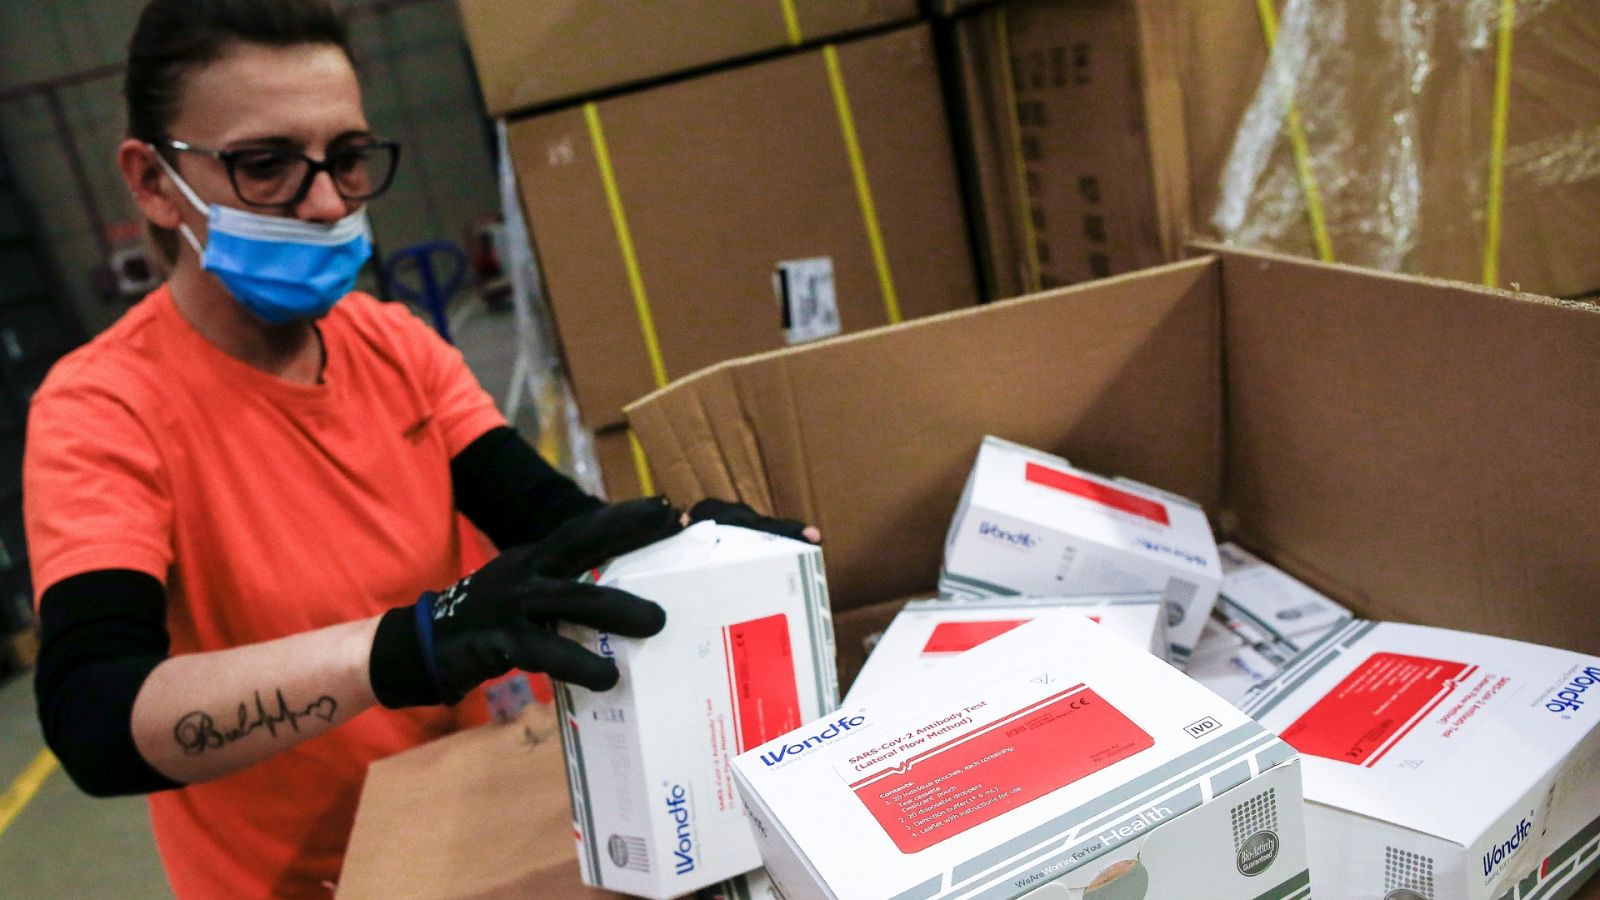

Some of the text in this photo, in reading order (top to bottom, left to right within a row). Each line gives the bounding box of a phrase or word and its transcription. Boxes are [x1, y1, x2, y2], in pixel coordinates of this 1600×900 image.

[760, 716, 865, 767] Wondfo
[849, 700, 988, 765] SARS-CoV-2 Antibody Test
[854, 717, 973, 772] (Lateral Flow Method)
[1190, 721, 1213, 734] IVD
[899, 786, 941, 808] Test cassette
[902, 781, 934, 799] individual
[964, 761, 980, 772] each
[937, 785, 958, 799] pouch
[907, 811, 918, 821] 20
[918, 797, 952, 816] disposable
[953, 783, 983, 801] droppers
[914, 810, 945, 828] Detection
[920, 820, 943, 834] Leaflet
[943, 813, 959, 825] with
[960, 797, 998, 817] instructions
[998, 791, 1008, 801] for
[1009, 785, 1024, 796] use
[666, 784, 695, 875] Wondfo
[1100, 806, 1173, 847] Health
[1241, 838, 1275, 864] Bio-Activity
